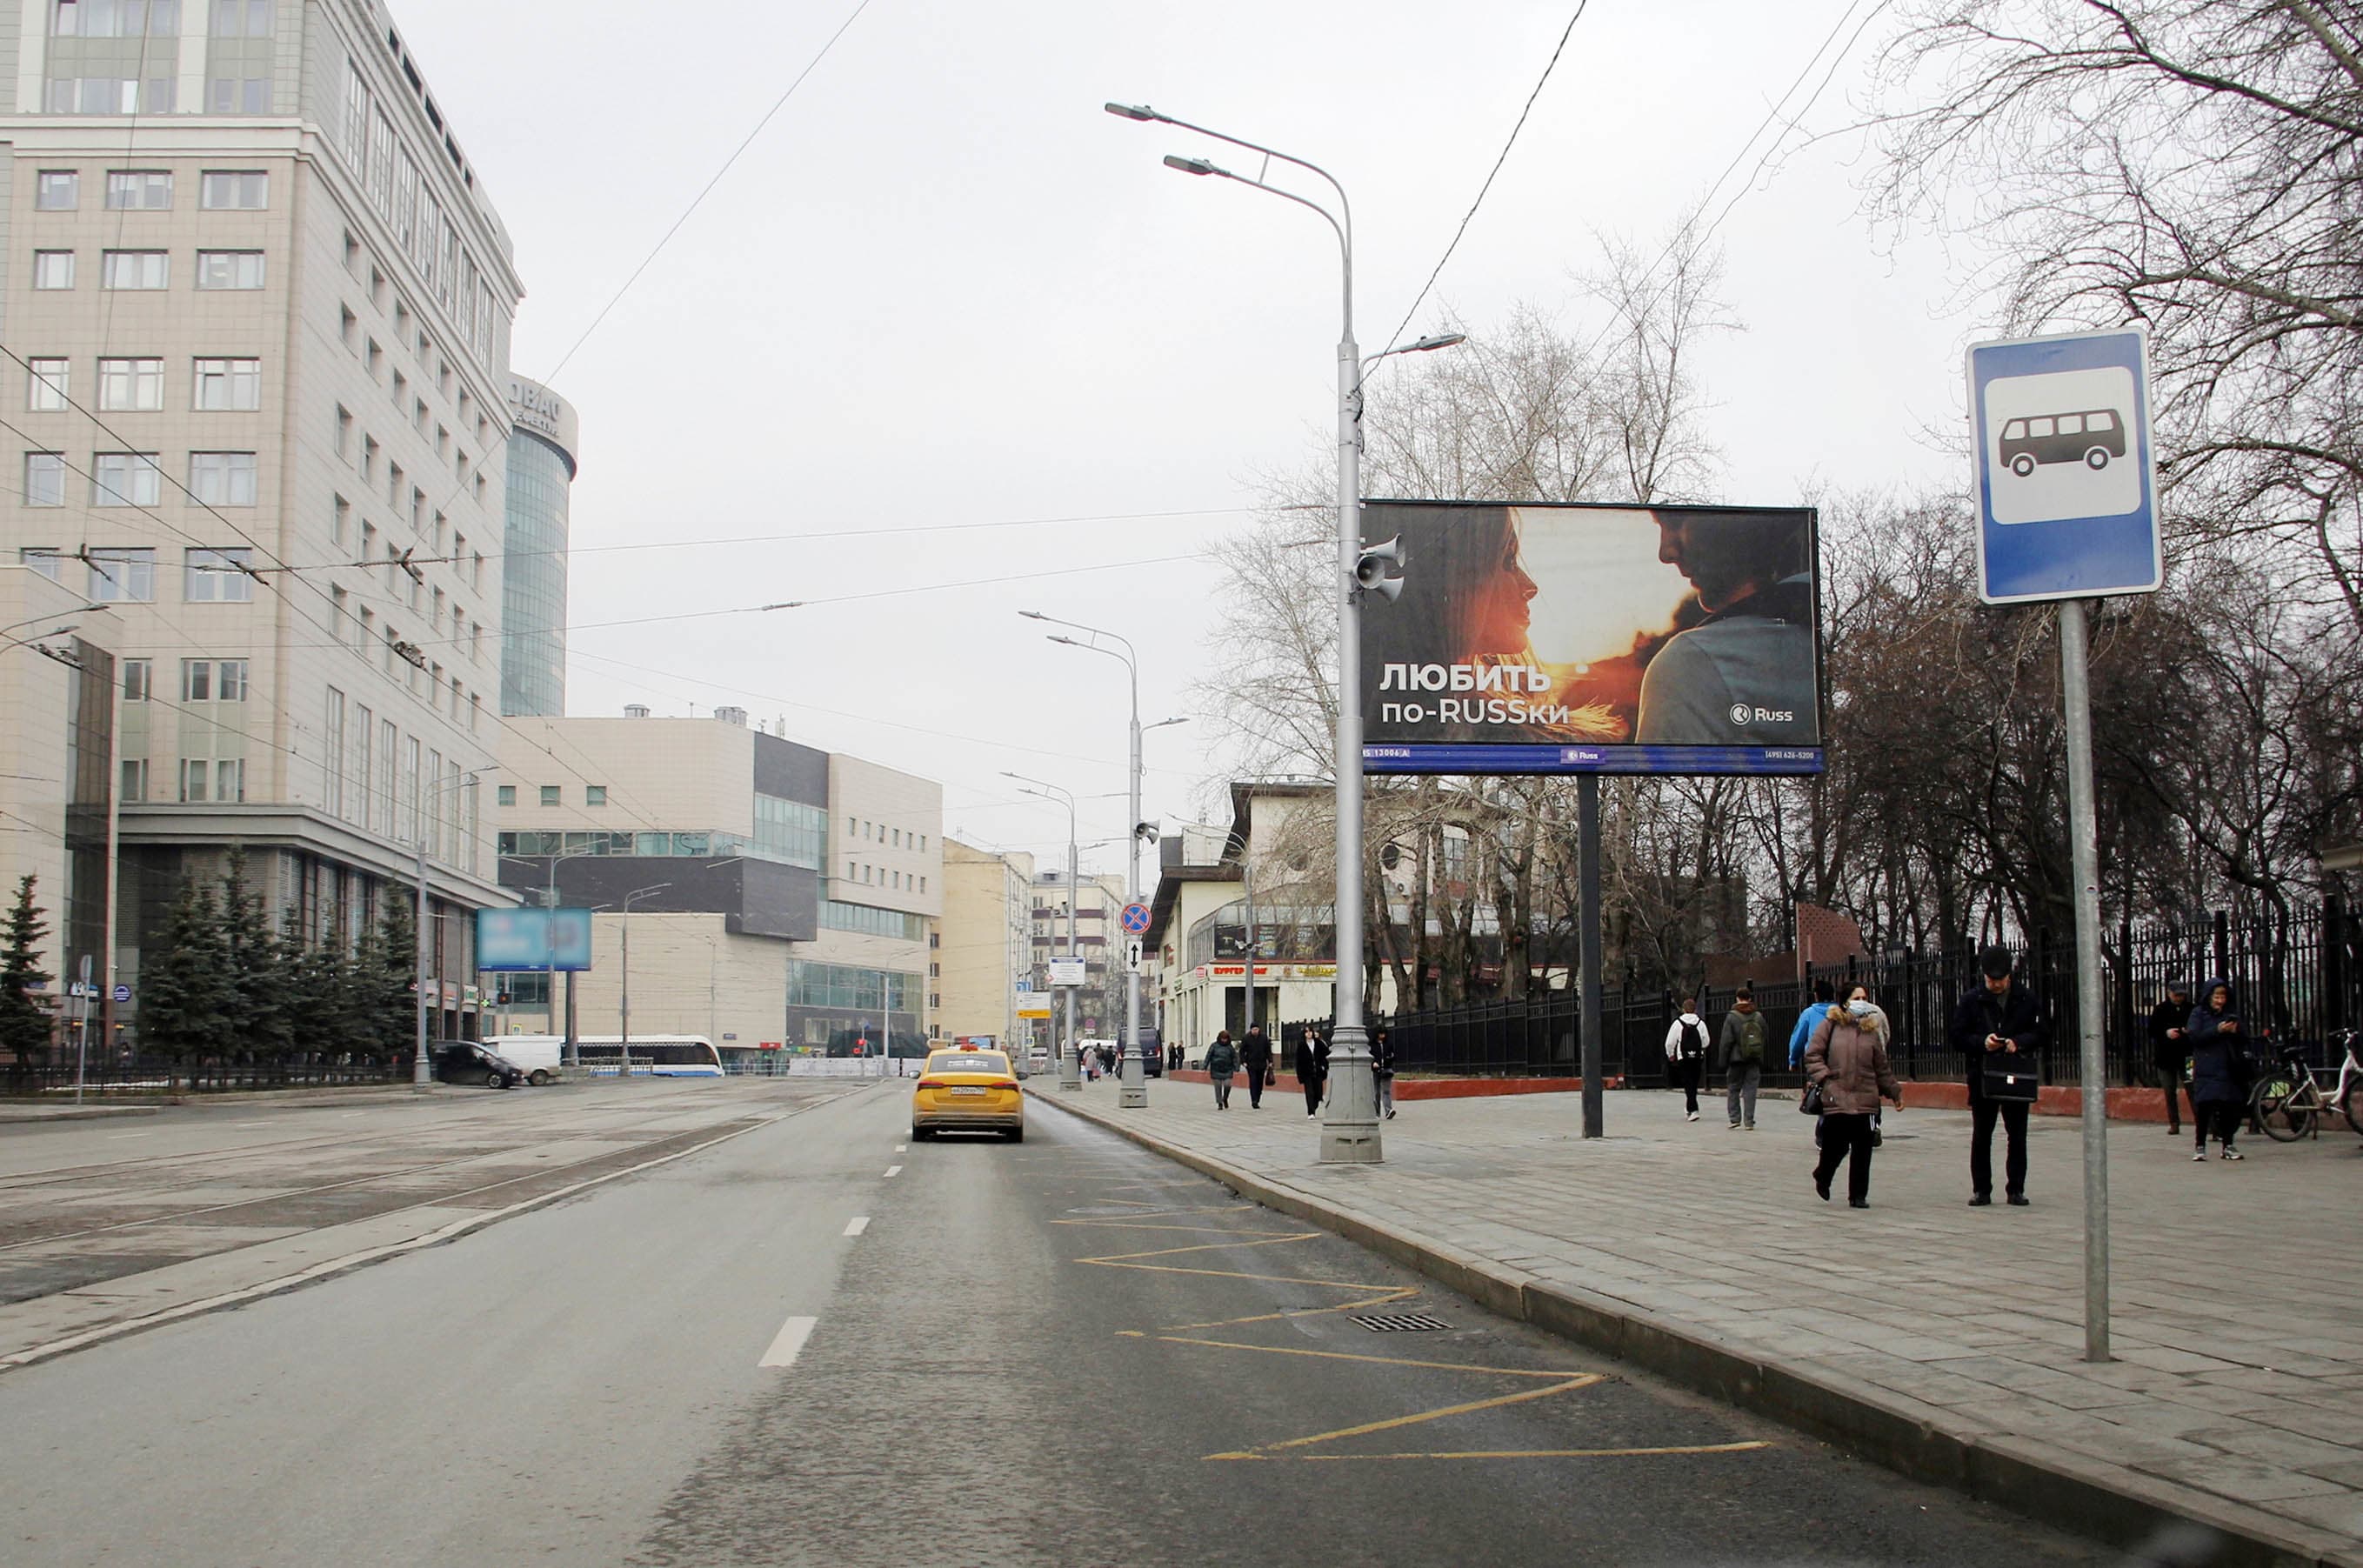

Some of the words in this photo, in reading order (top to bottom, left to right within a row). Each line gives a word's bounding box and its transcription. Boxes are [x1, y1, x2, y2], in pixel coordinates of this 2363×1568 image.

[1379, 664, 1552, 692] ЛЮБИТЬ
[1382, 698, 1570, 724] по-RUSSки
[1754, 708, 1793, 722] Russ
